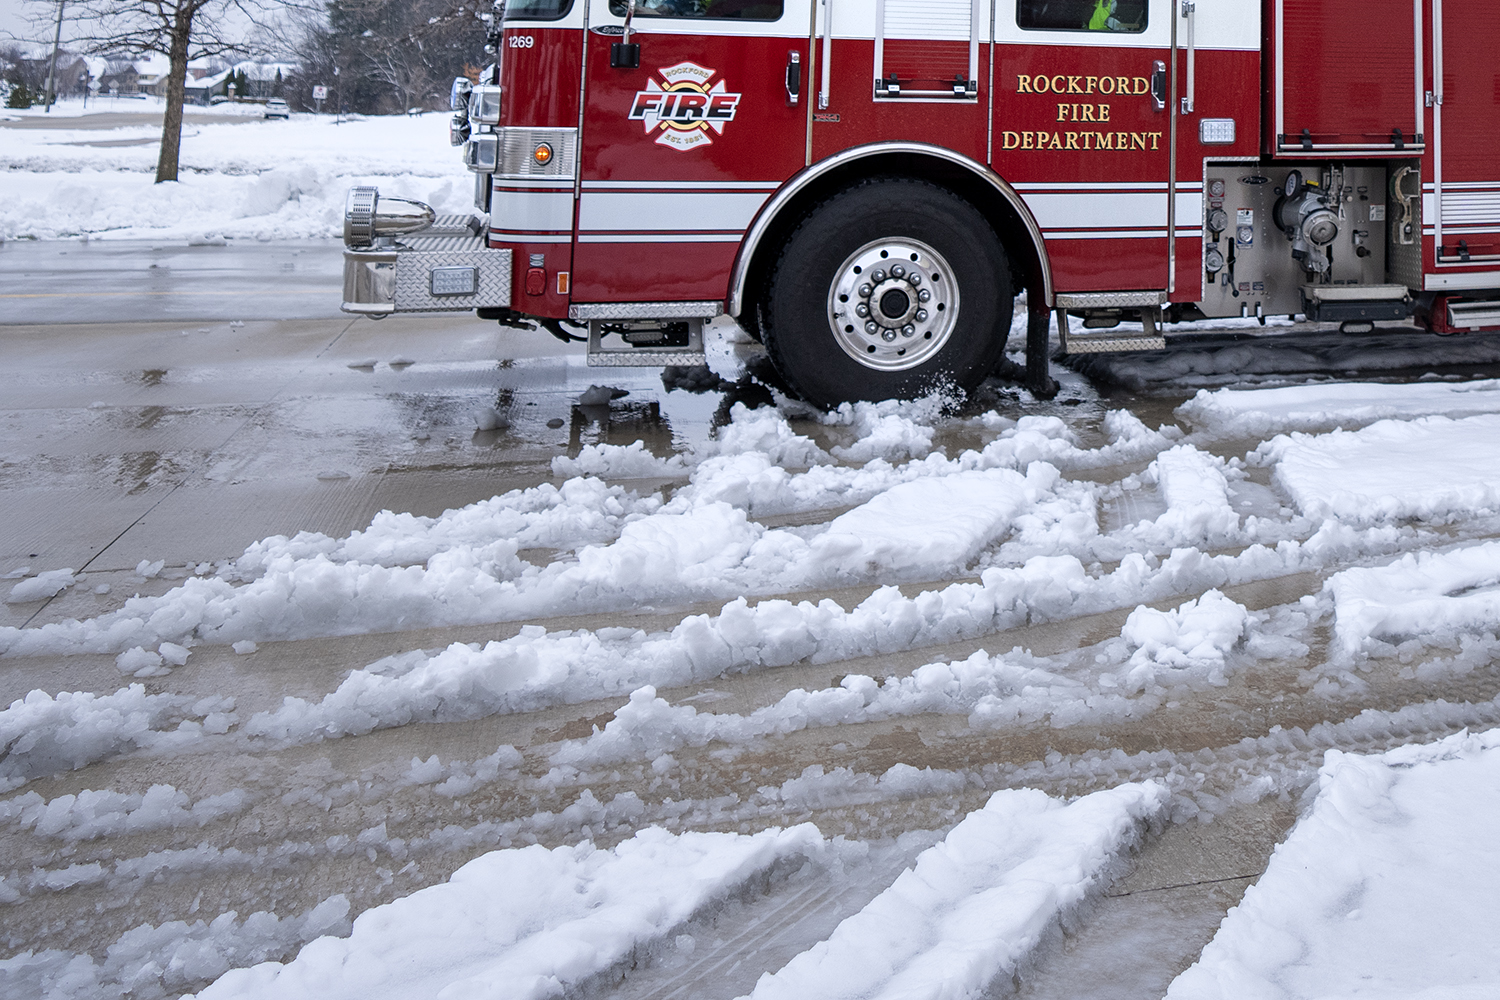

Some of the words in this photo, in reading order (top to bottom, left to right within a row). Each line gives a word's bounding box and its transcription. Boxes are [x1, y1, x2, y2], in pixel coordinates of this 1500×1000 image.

[508, 35, 534, 48] 1269
[665, 67, 710, 79] ROCKFORD
[1017, 74, 1150, 95] ROCKFORD
[629, 91, 741, 120] FIRE
[1057, 103, 1110, 122] FIRE
[1002, 131, 1162, 150] DEPARTMENT
